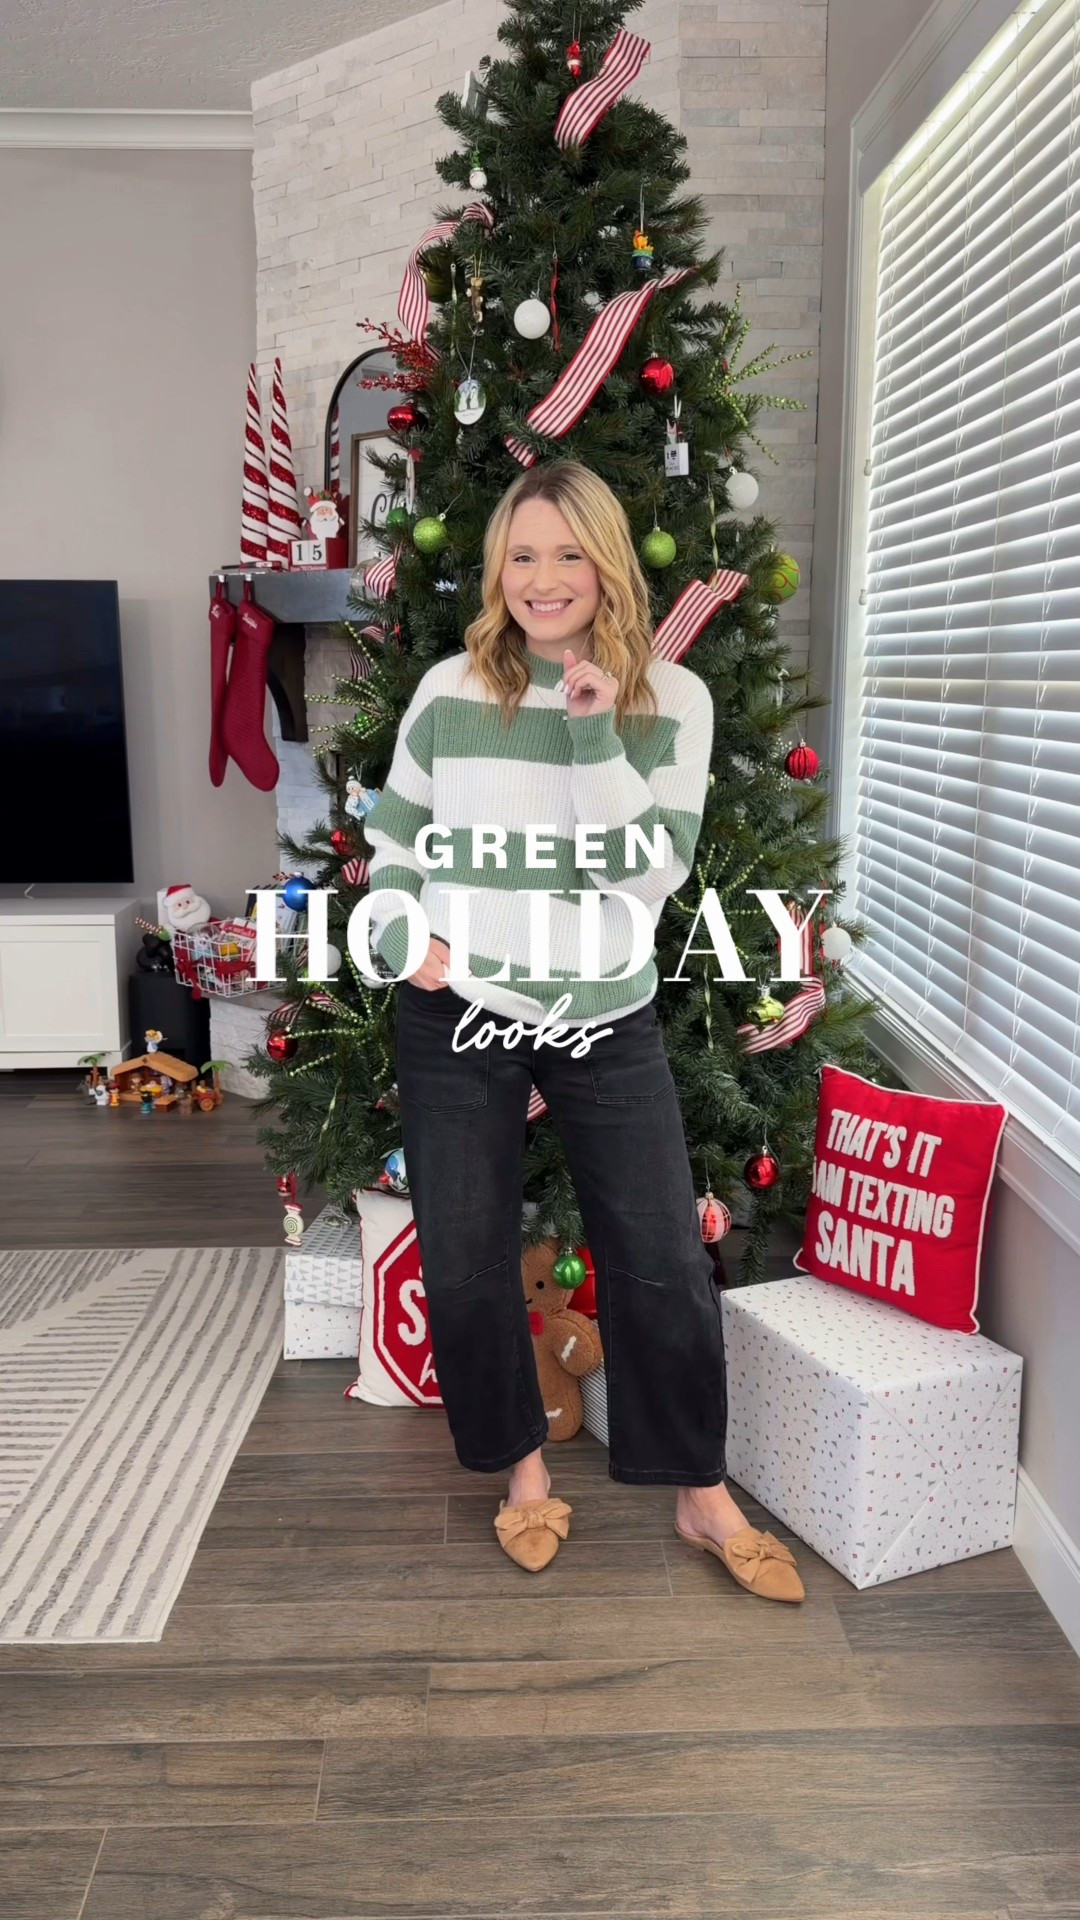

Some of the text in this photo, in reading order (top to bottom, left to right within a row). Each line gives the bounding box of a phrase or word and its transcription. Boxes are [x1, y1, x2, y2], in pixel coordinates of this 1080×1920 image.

[826, 1108, 942, 1178] THAT'S IT
[816, 1160, 846, 1207] AM
[847, 1170, 955, 1238] TEXTING
[815, 1210, 916, 1296] SANTA
